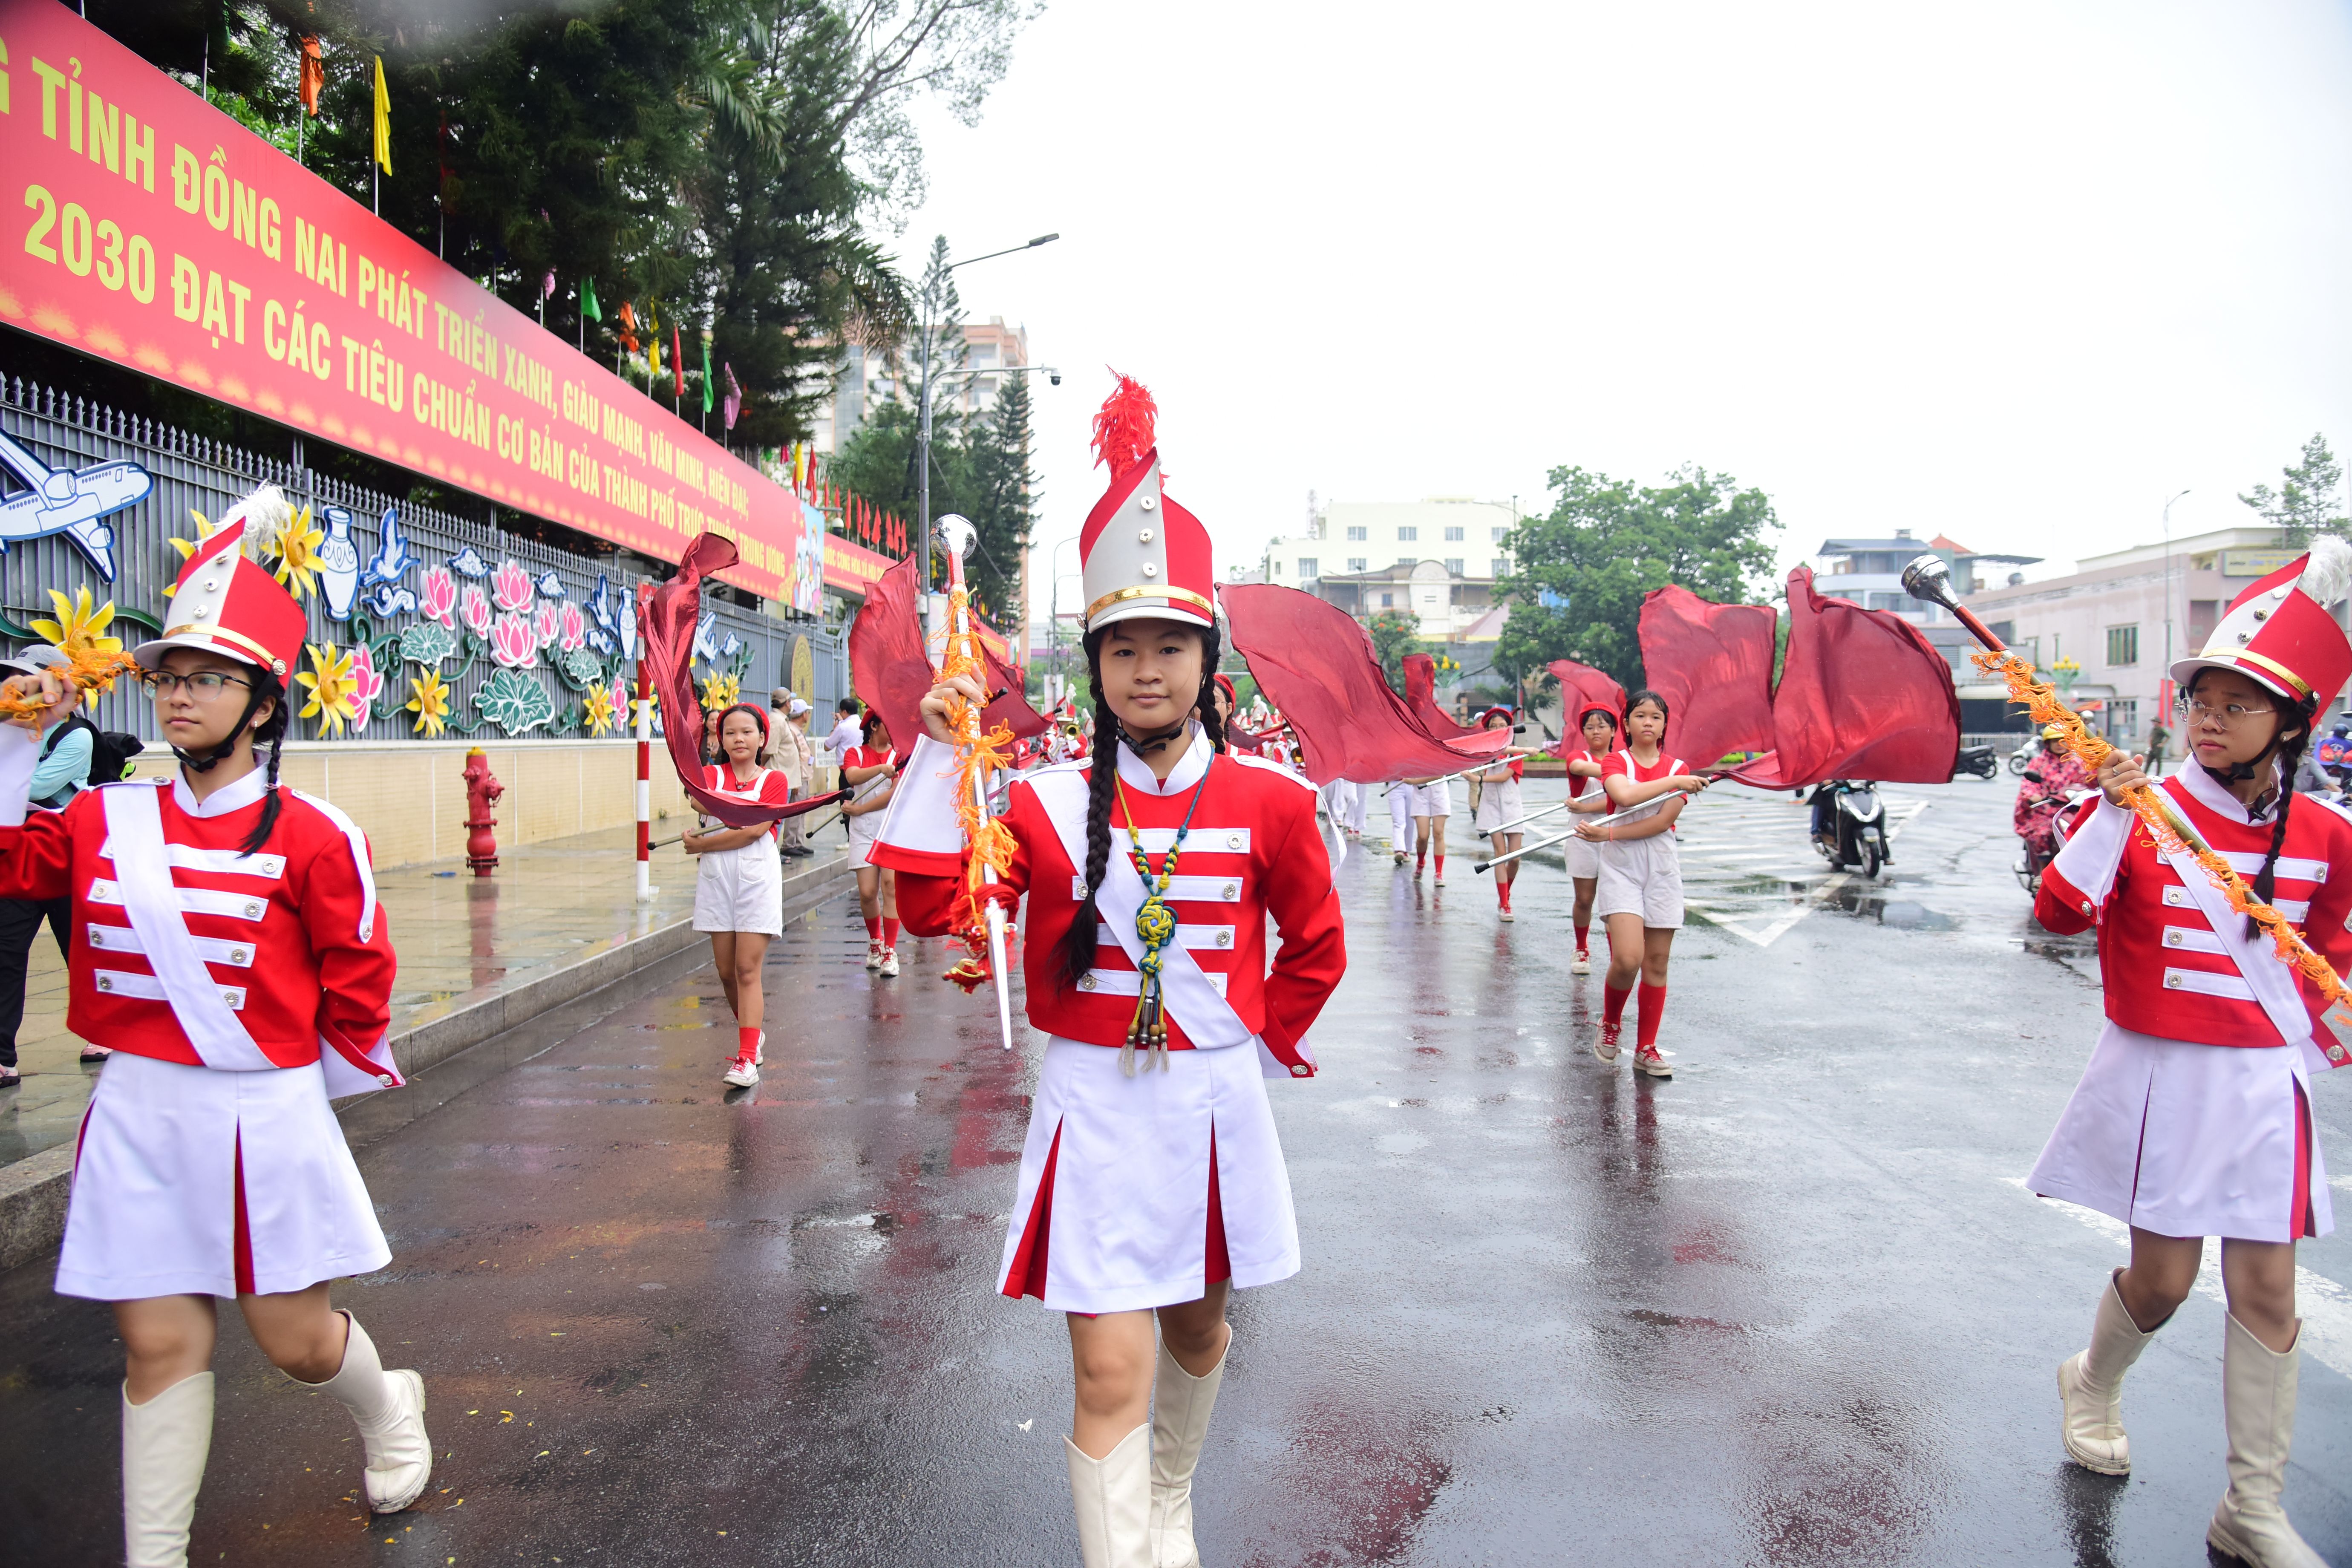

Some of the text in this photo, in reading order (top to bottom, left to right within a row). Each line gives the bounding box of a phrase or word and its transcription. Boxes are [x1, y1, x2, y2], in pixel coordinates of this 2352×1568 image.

[25, 184, 155, 304] 2030
[171, 254, 251, 349] ĐẠT
[264, 299, 331, 380] CÁC
[342, 334, 404, 412] TIÊU
[413, 372, 490, 451] CHUẨN
[497, 413, 524, 464] CƠ
[530, 424, 563, 482] BẢN
[569, 442, 600, 498] CỦA
[603, 464, 647, 519] THÀNH
[651, 486, 675, 530] PHỐ
[739, 532, 764, 570] TRUNG
[32, 56, 154, 194] TỈNH
[171, 144, 281, 262] ĐỒNG
[295, 216, 346, 298] NAI
[359, 254, 427, 340] PHÁT
[435, 300, 497, 380] TRIỂN
[504, 343, 557, 420] XANH,
[563, 379, 599, 435] GIÀU
[603, 403, 646, 466] MẠNH,
[649, 429, 672, 475] VĂN
[676, 447, 706, 499] MINH,
[709, 466, 729, 510] HIỆN
